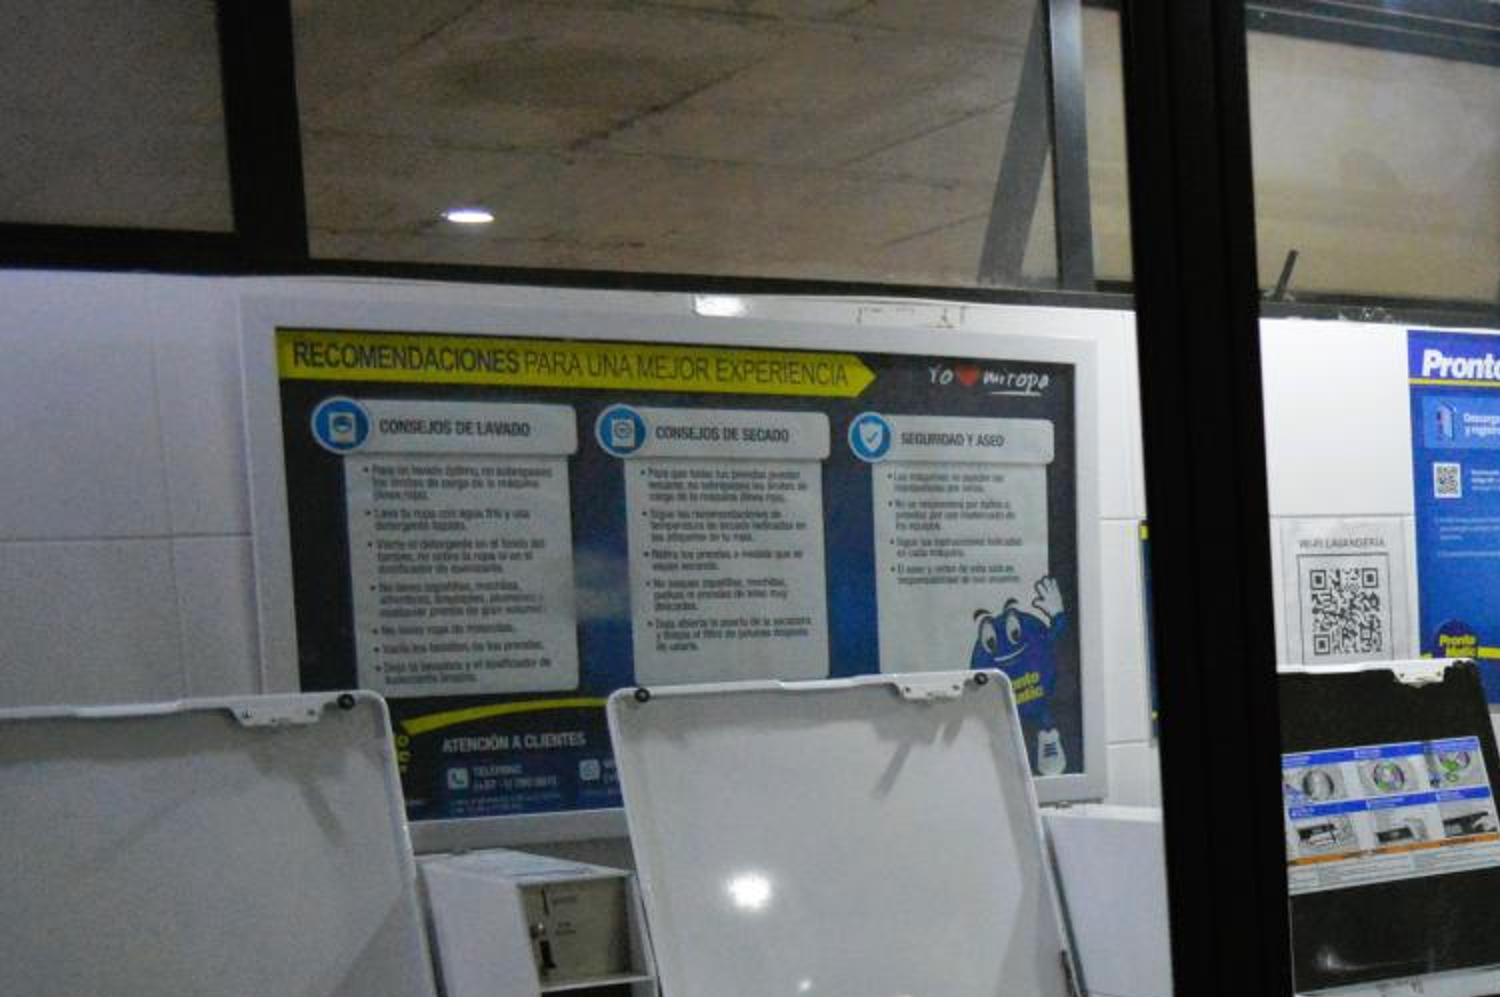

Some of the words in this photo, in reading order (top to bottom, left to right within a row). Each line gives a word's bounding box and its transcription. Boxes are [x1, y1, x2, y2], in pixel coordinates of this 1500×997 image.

[293, 341, 520, 374] RECOMENDACIONES
[523, 351, 581, 376] PARA
[588, 354, 633, 379] UNA
[637, 355, 710, 381] MEJOR
[716, 358, 849, 386] EXPERIENCIA
[928, 364, 954, 385] Yo
[378, 418, 451, 436] CONSEJOS
[455, 420, 476, 436] DE
[477, 421, 531, 437] LAVADO
[656, 425, 720, 442] CONSEJOS
[724, 427, 739, 442] DE
[742, 427, 790, 443] SECADO
[901, 432, 965, 447] SEGURIDAD
[967, 434, 975, 447] Y
[976, 435, 1005, 448] ASEO
[443, 734, 509, 752] ATENCIÓN
[512, 735, 524, 749] A
[525, 731, 587, 748] CLIENTES
